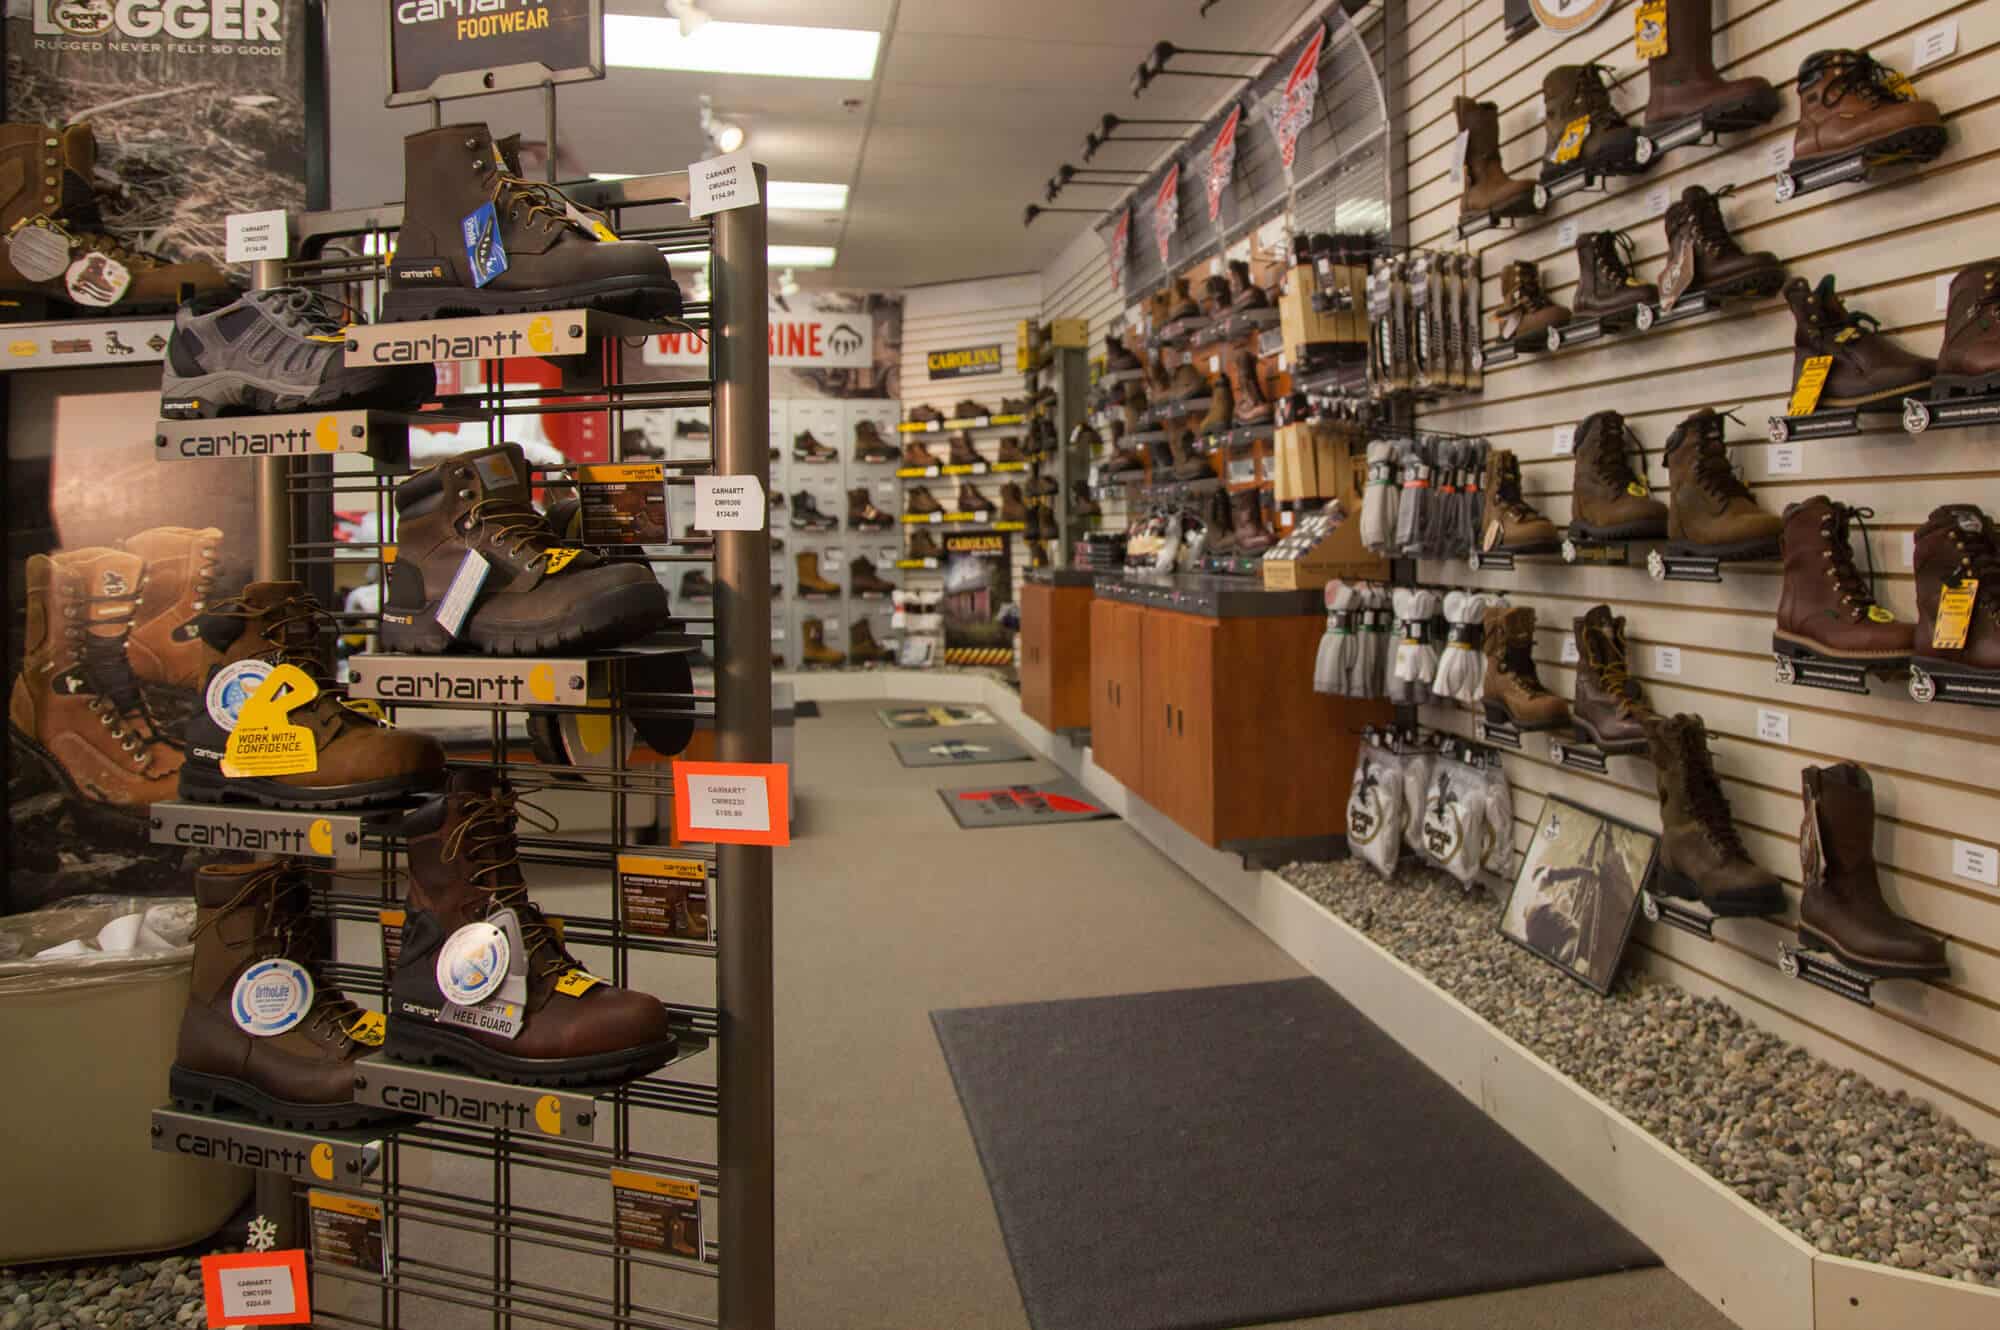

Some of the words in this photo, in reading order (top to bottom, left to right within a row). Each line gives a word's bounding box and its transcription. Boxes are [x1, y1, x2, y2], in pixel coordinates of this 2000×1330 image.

[32, 0, 282, 41] LGGER
[70, 19, 100, 30] Boot
[457, 7, 549, 41] FOOTWEAR
[34, 39, 102, 52] RUGGED
[108, 42, 162, 54] NEVER
[167, 43, 207, 54] FELT
[211, 45, 233, 55] SO
[237, 45, 281, 56] GOOD
[705, 166, 737, 180] CARHARTT
[400, 270, 432, 279] carhartt
[373, 329, 522, 363] carhartt
[927, 347, 999, 371] CAROLINA
[179, 427, 311, 457] carhartt
[711, 487, 745, 495] CARHARTT
[946, 535, 1003, 552] CAROLINA
[376, 671, 525, 701] carhartt
[238, 733, 270, 745] WORK
[272, 731, 298, 743] WITH
[707, 786, 746, 794] CARHARTT
[174, 821, 305, 853] carhartt
[453, 1010, 479, 1026] HEEL
[480, 1015, 513, 1034] GUARD
[381, 1085, 531, 1129] carhartt
[175, 1132, 306, 1174] carhartt
[237, 1279, 273, 1288] CARHARTT
